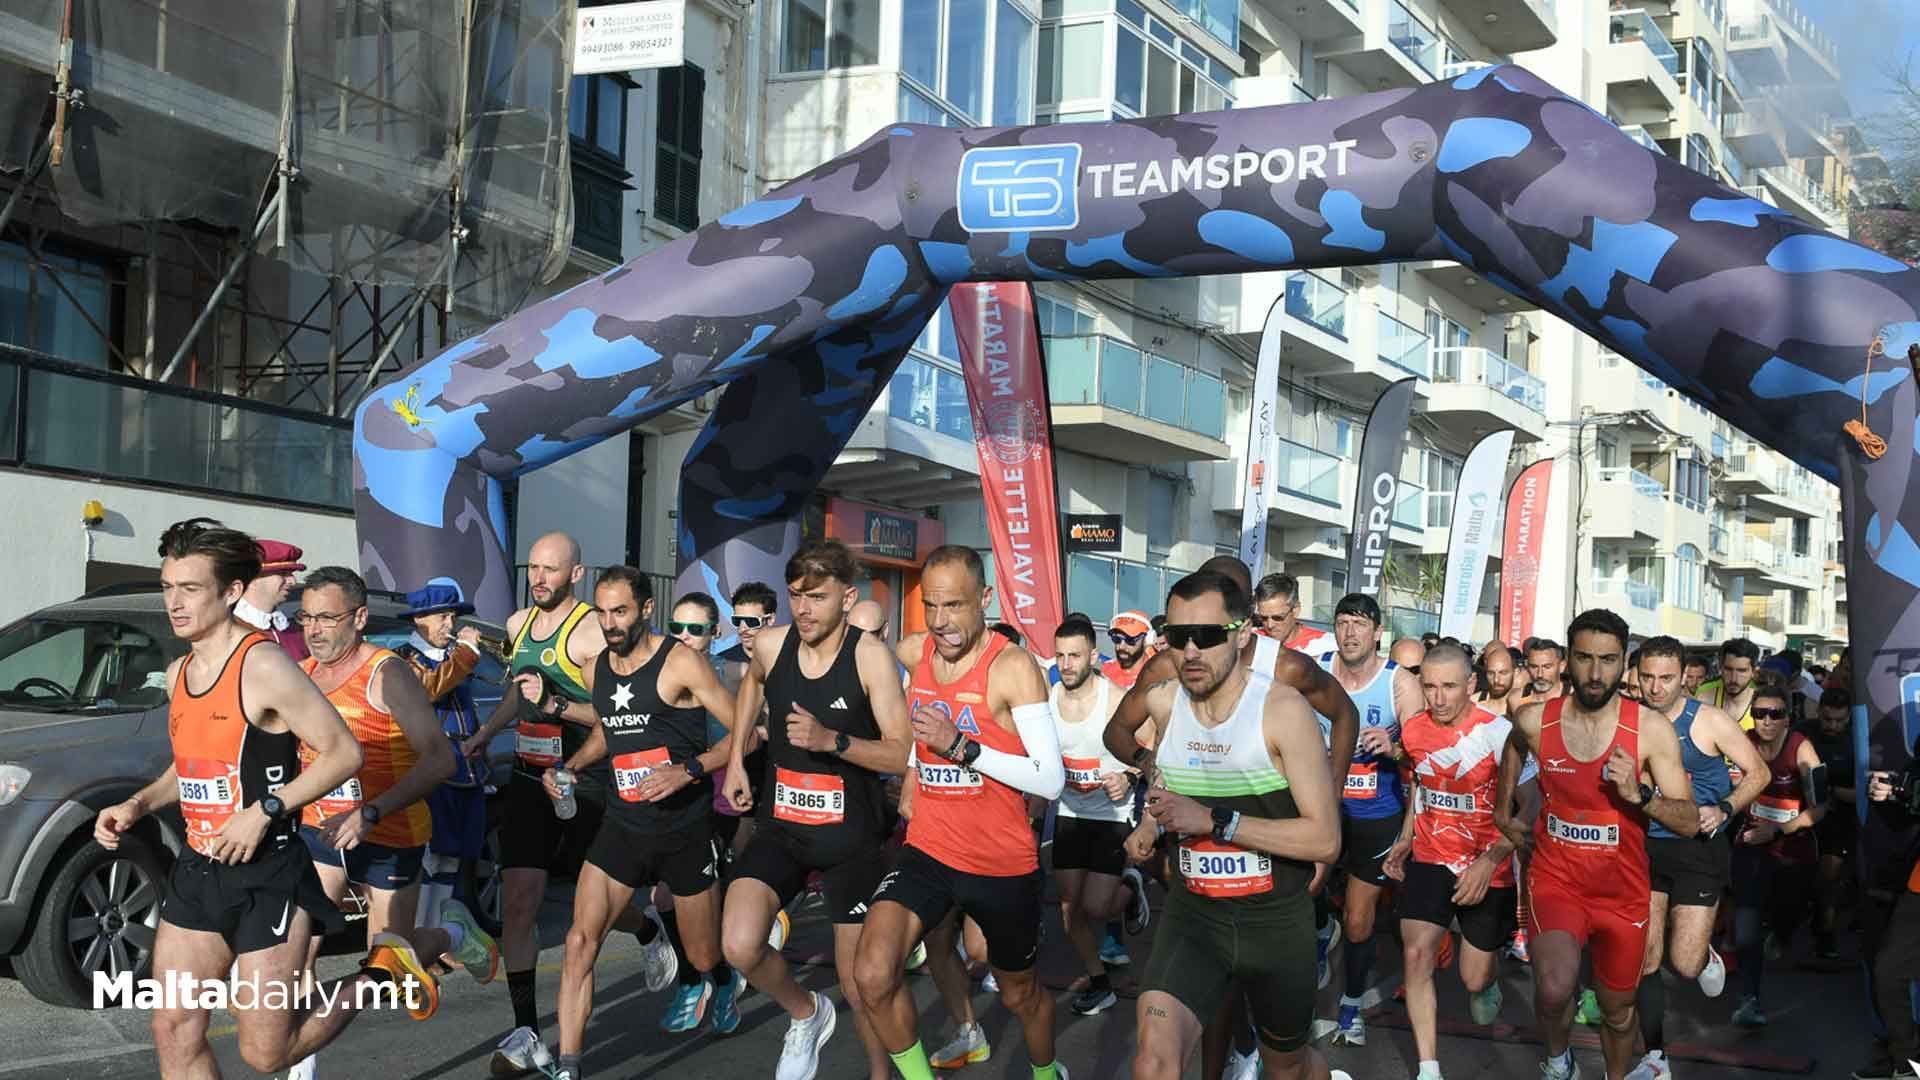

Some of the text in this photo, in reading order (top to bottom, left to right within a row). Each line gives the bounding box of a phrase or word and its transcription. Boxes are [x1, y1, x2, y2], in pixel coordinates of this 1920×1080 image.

[1086, 140, 1357, 198] TEAMSPORT
[1518, 477, 1537, 553] MARATHON
[1081, 528, 1115, 538] MAMO
[1360, 472, 1396, 594] HiPRO
[602, 713, 651, 728] SAYSKY
[924, 767, 961, 783] 3737
[180, 781, 209, 800] 3581
[789, 791, 825, 808] 3865
[1430, 792, 1459, 808] 3261
[1561, 824, 1601, 841] 3000
[1199, 855, 1247, 875] 3001
